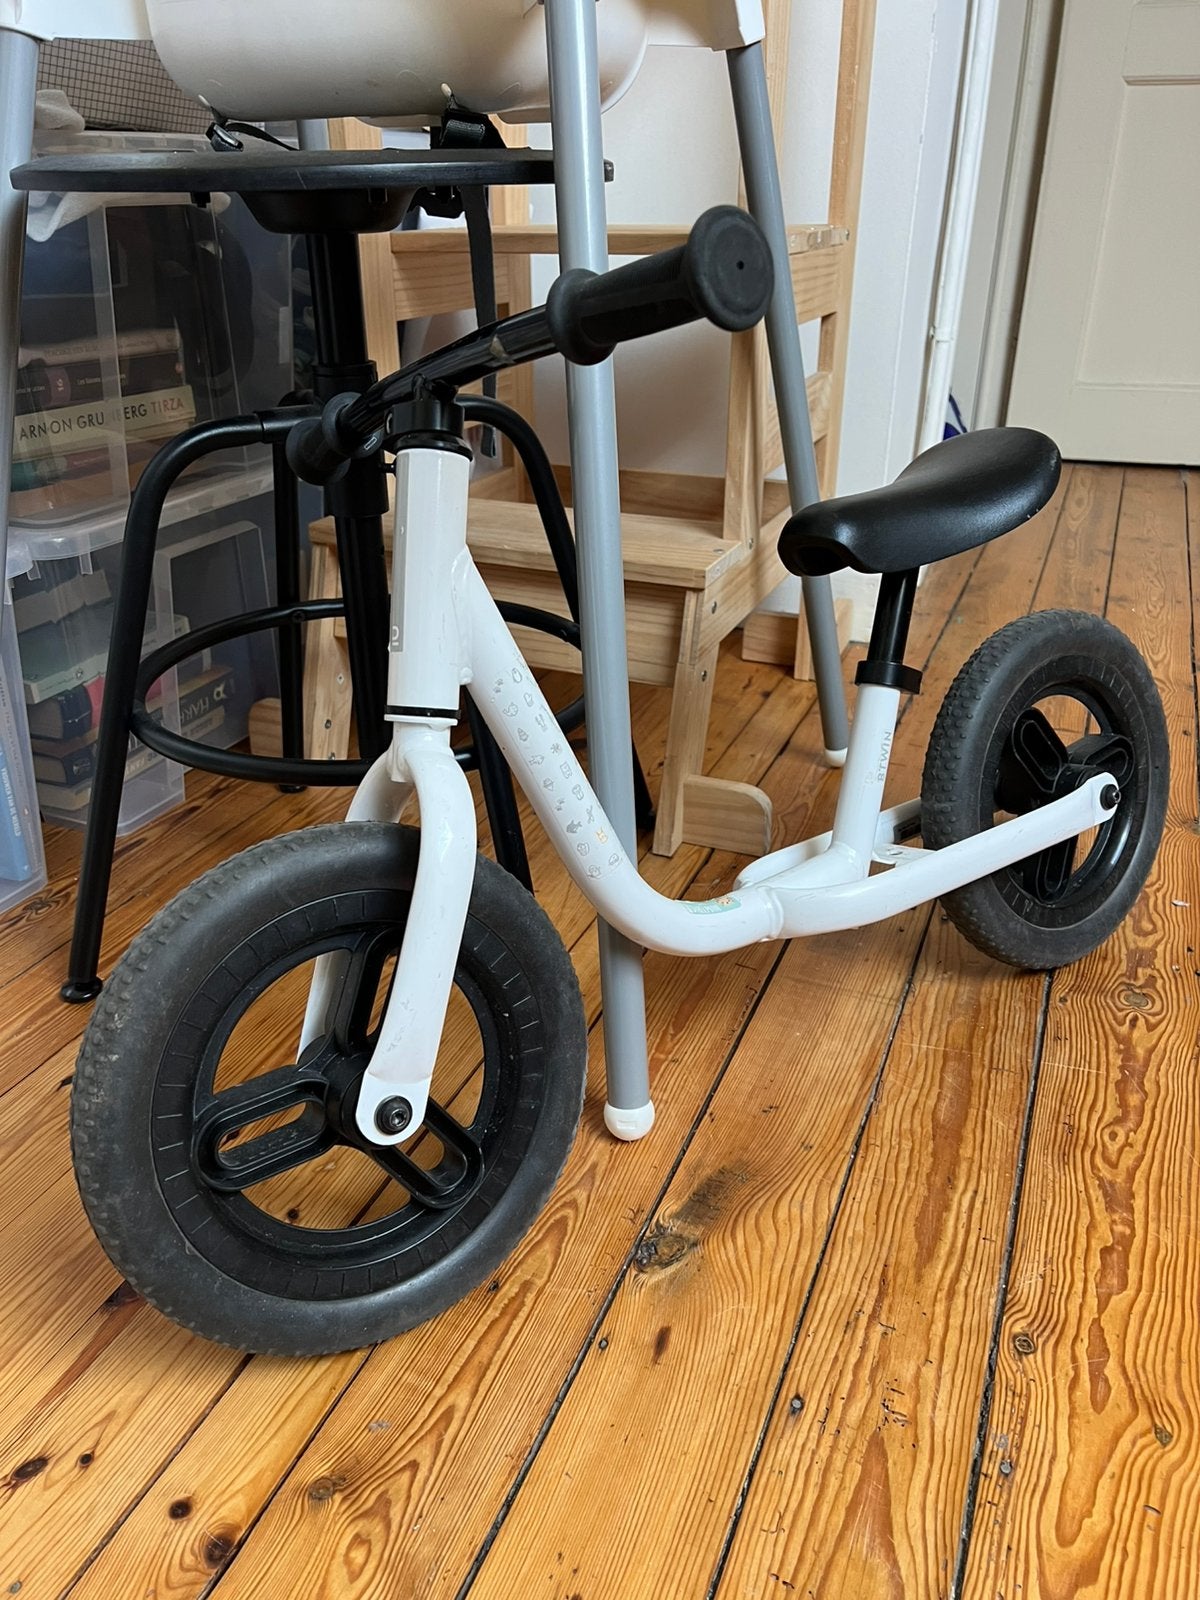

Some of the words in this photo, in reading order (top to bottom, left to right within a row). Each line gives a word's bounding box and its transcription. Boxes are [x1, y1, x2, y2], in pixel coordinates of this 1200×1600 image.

[19, 419, 72, 441] ARNON
[76, 403, 148, 429] GRUERG
[151, 397, 185, 413] TIRZA
